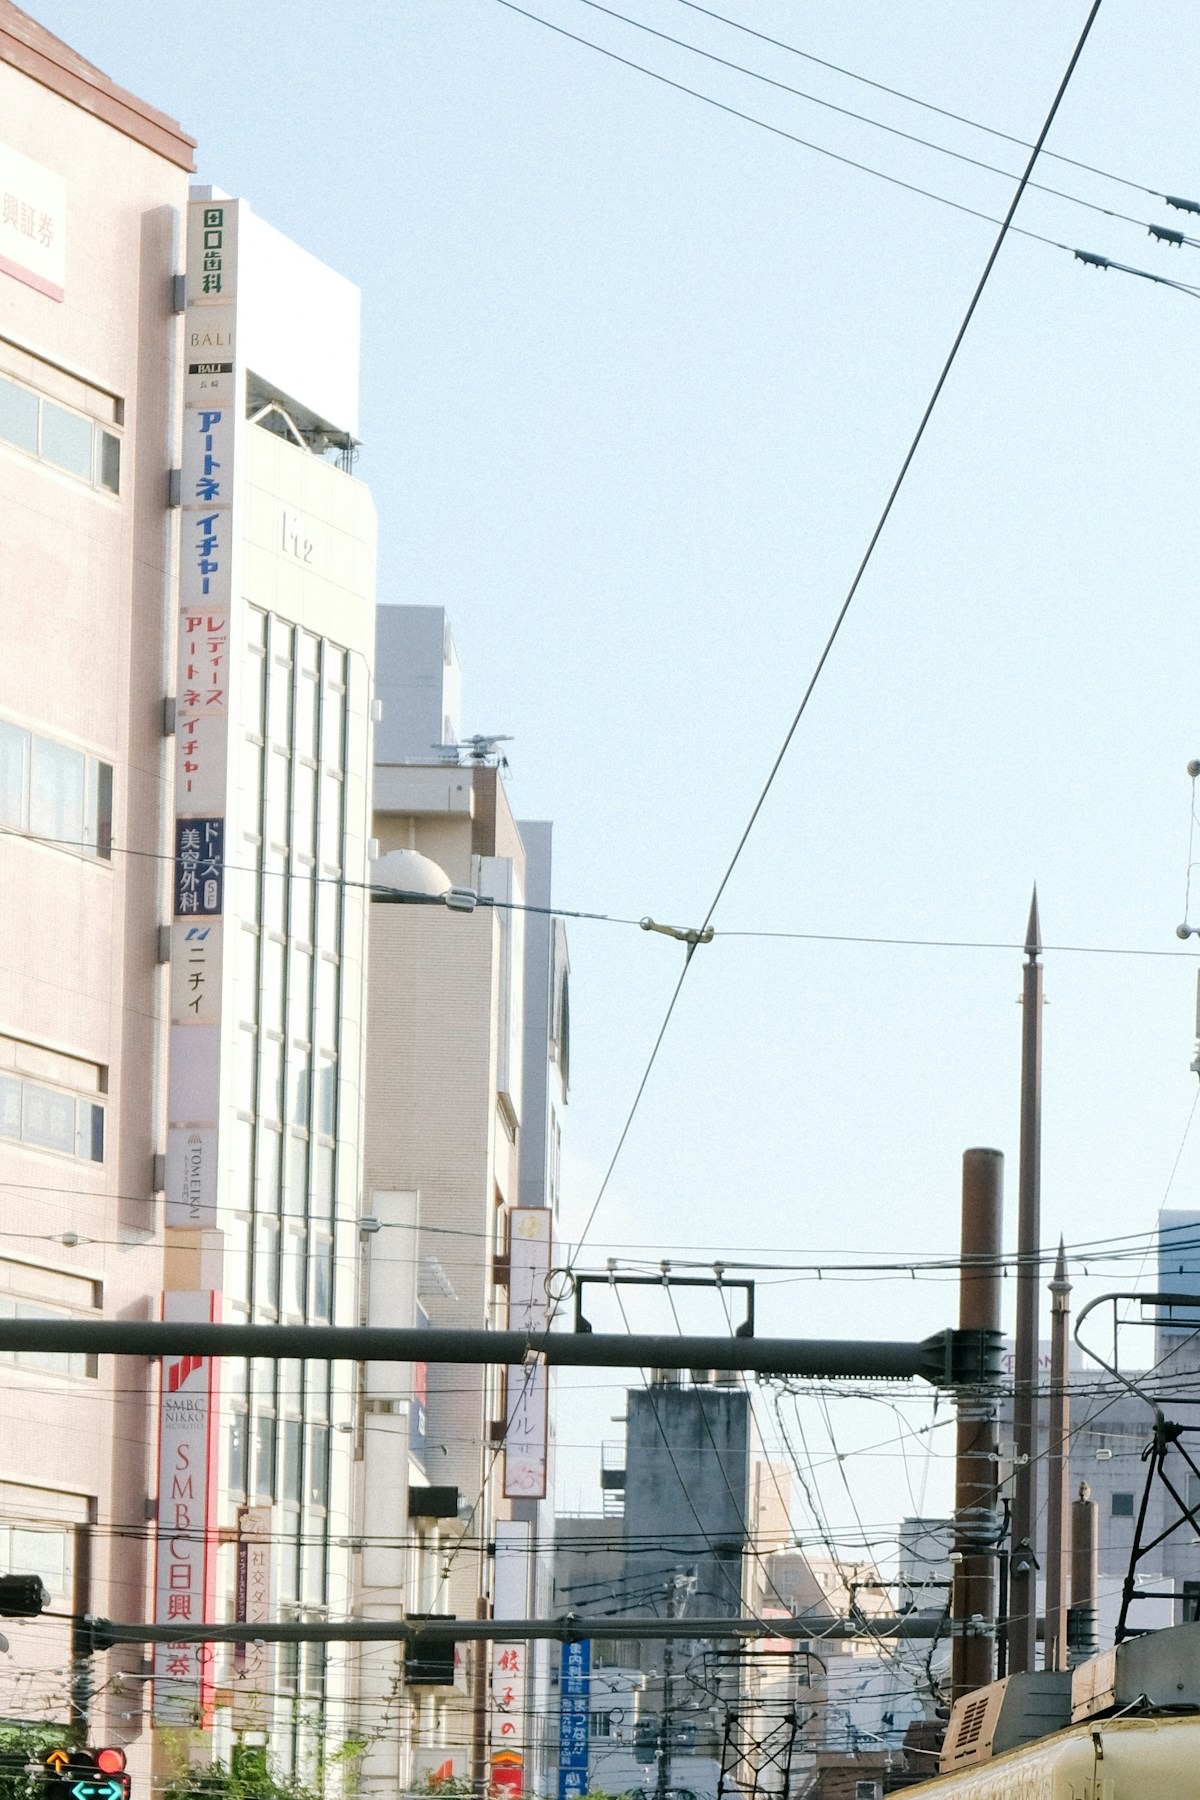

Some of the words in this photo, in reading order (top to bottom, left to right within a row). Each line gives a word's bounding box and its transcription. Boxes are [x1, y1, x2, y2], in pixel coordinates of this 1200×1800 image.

[203, 208, 223, 293] 田口歯科
[190, 332, 232, 347] BALI
[197, 362, 222, 374] BALI
[205, 616, 226, 705] レディース
[201, 822, 219, 876] ドーズ
[179, 828, 200, 912] 美容外科
[207, 882, 214, 906] 5F
[165, 1412, 204, 1423] NIKKO
